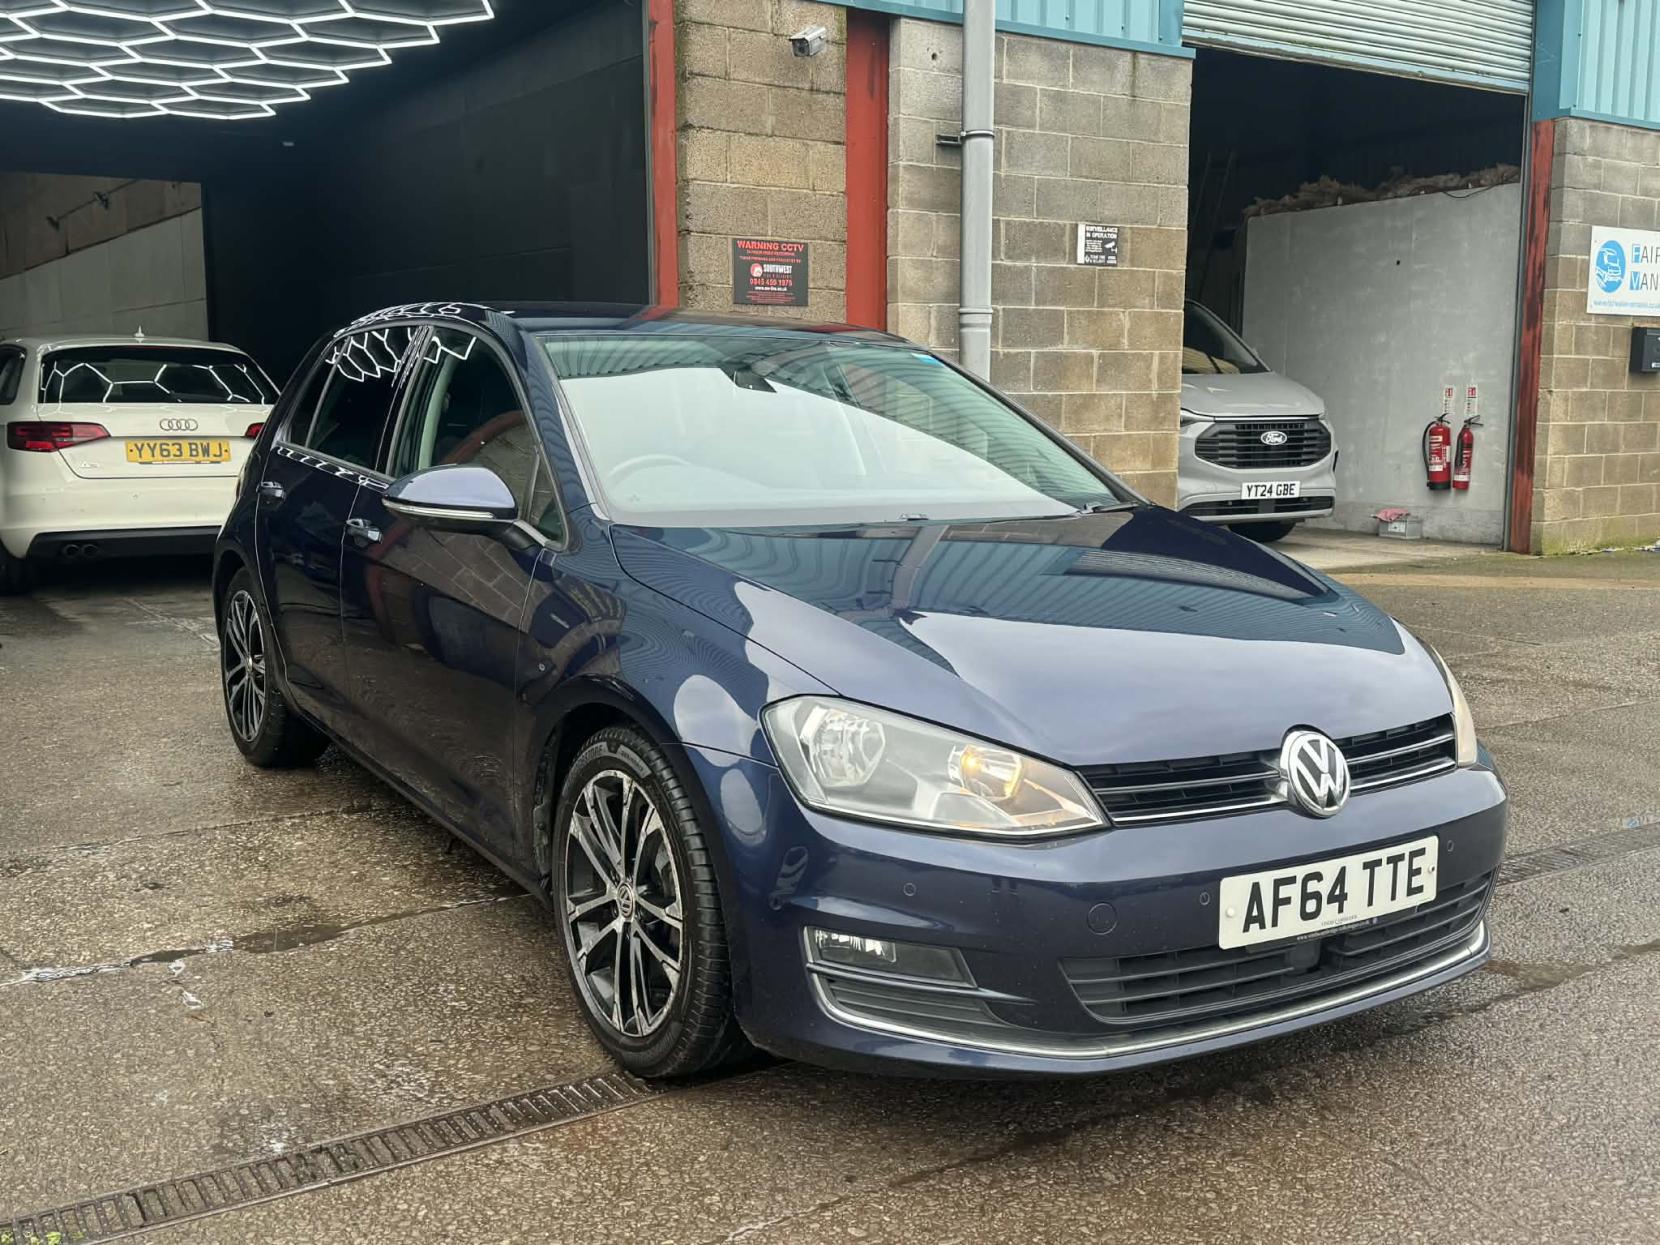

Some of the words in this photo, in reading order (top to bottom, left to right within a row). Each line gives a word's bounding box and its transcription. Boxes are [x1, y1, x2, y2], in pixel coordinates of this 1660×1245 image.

[736, 240, 779, 250] WARNING
[781, 243, 804, 252] CCTV
[134, 442, 183, 458] YY63
[188, 443, 223, 458] BWJ
[1246, 484, 1273, 497] YT24
[1276, 483, 1296, 496] GBE
[1242, 865, 1348, 934] AF64
[1362, 846, 1426, 908] TTE
